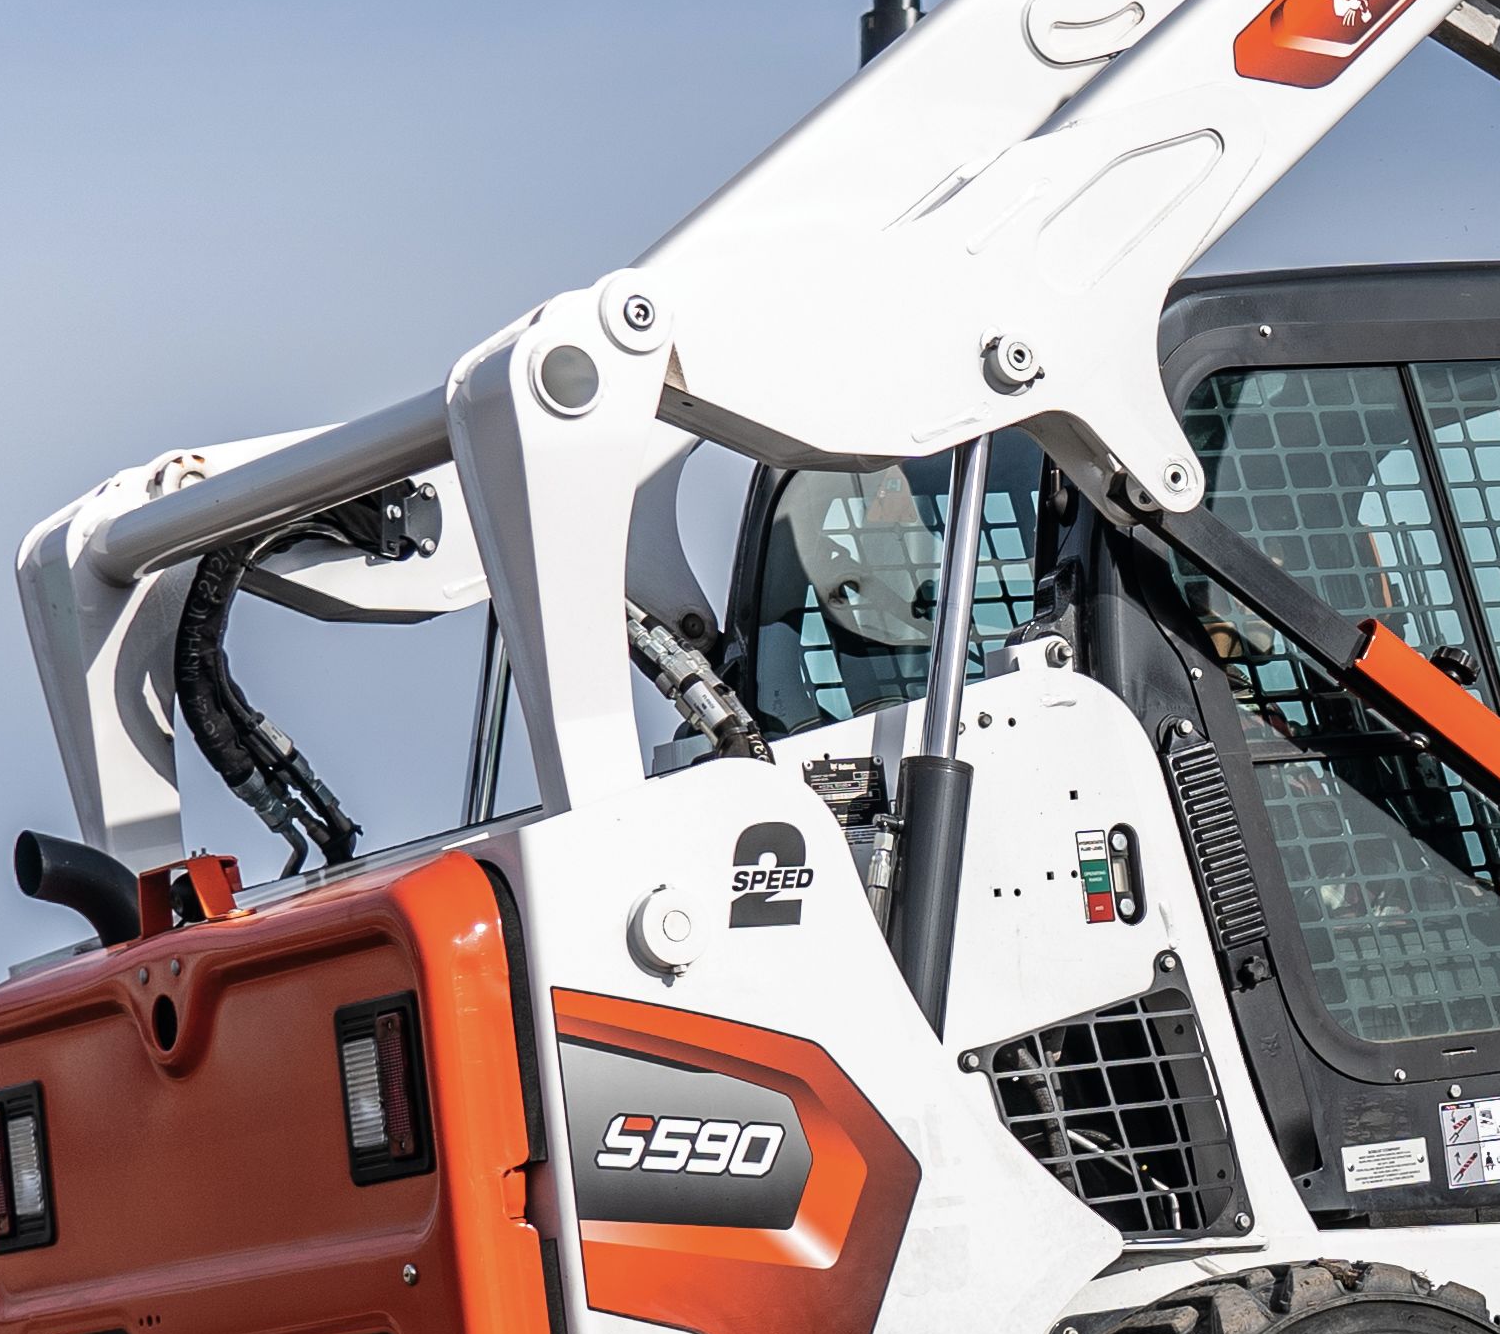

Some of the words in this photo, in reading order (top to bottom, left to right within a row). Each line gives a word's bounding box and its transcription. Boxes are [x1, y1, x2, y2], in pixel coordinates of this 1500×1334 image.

[729, 822, 806, 928] 2
[731, 868, 814, 892] SPEED
[595, 1113, 786, 1178] S590
